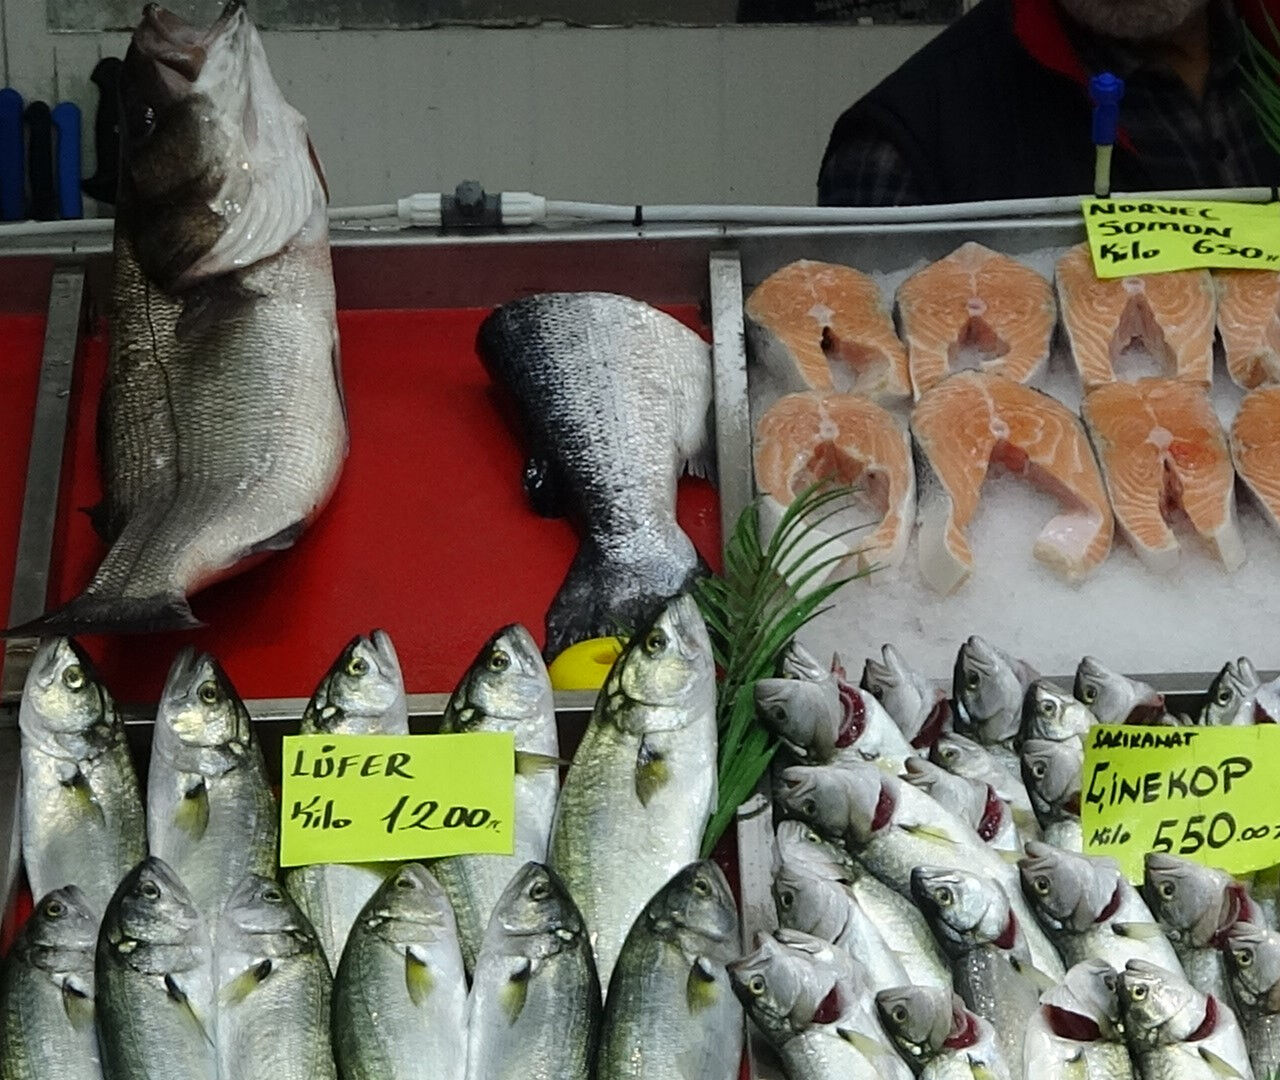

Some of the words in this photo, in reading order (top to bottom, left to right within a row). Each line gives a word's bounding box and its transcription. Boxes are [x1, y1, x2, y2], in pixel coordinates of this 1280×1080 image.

[1097, 220, 1233, 238] SOMON
[1099, 241, 1161, 264] Kilo
[290, 795, 352, 829] Kilo
